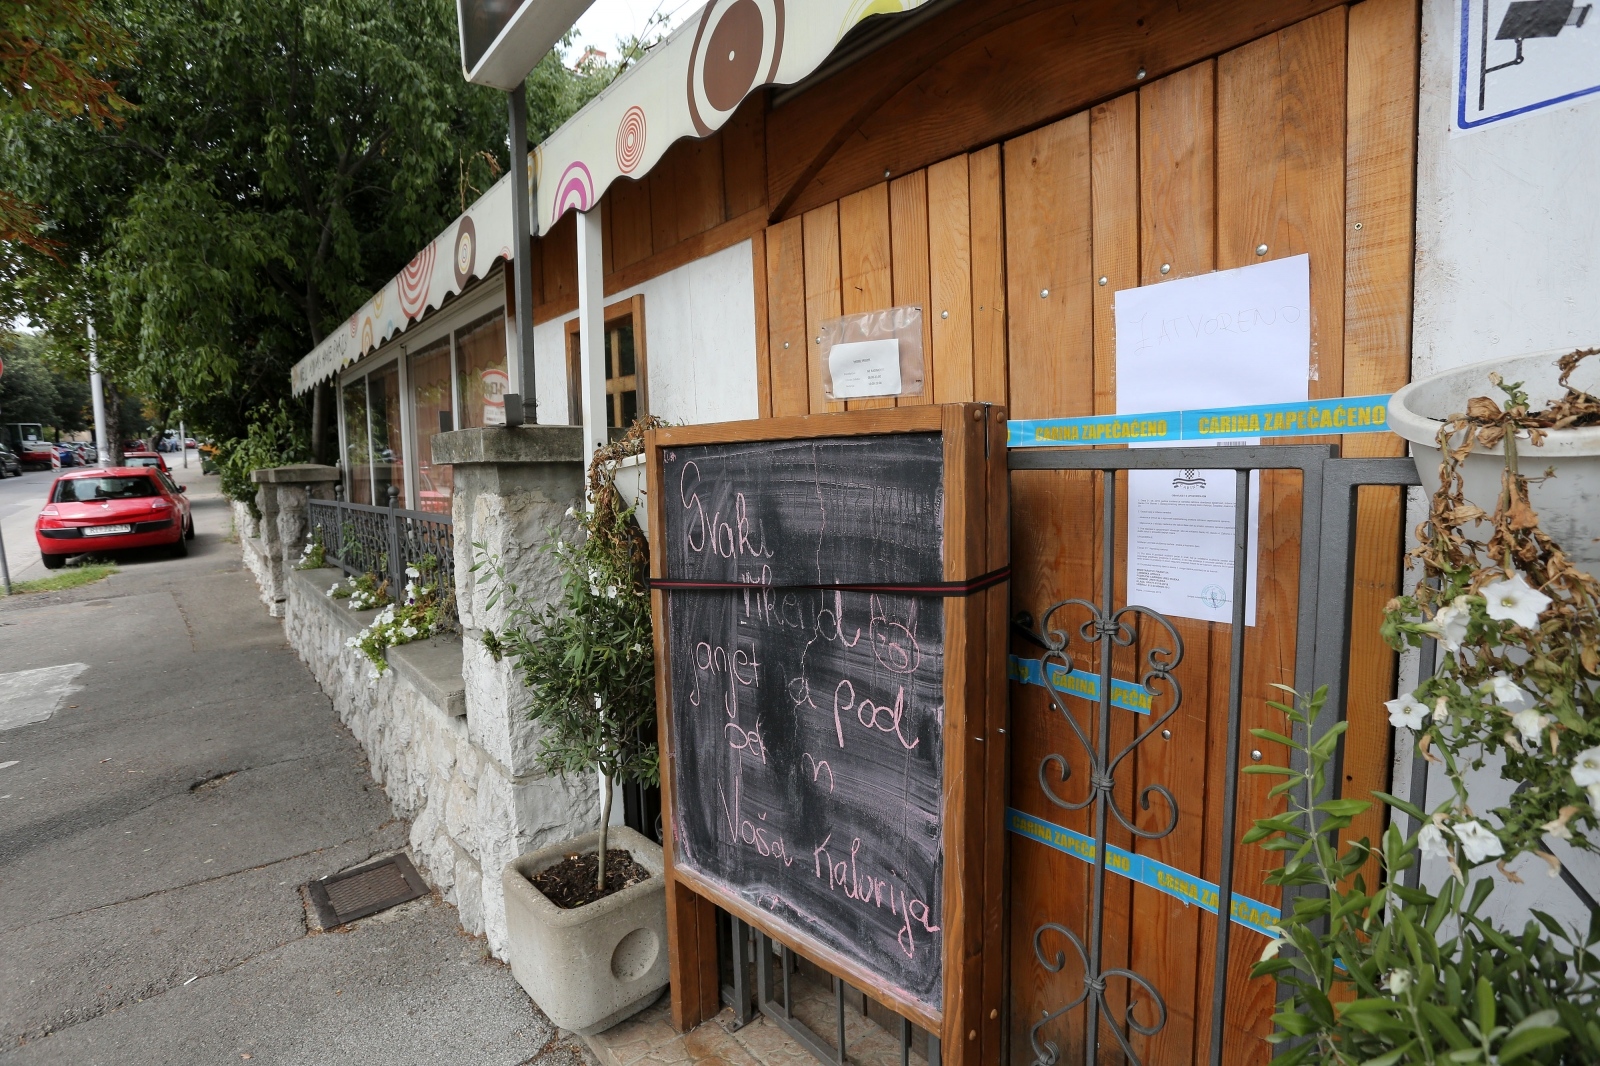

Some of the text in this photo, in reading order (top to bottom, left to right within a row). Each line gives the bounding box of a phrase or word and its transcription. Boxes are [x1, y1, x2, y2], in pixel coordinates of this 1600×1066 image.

[1035, 419, 1168, 441] CARINA ZAPEČAĆENO
[1198, 404, 1386, 434] CARINA ZAPEČAĆENO
[1051, 670, 1096, 697] CARINA
[1012, 815, 1131, 872] CARINA ZAPEČAENO
